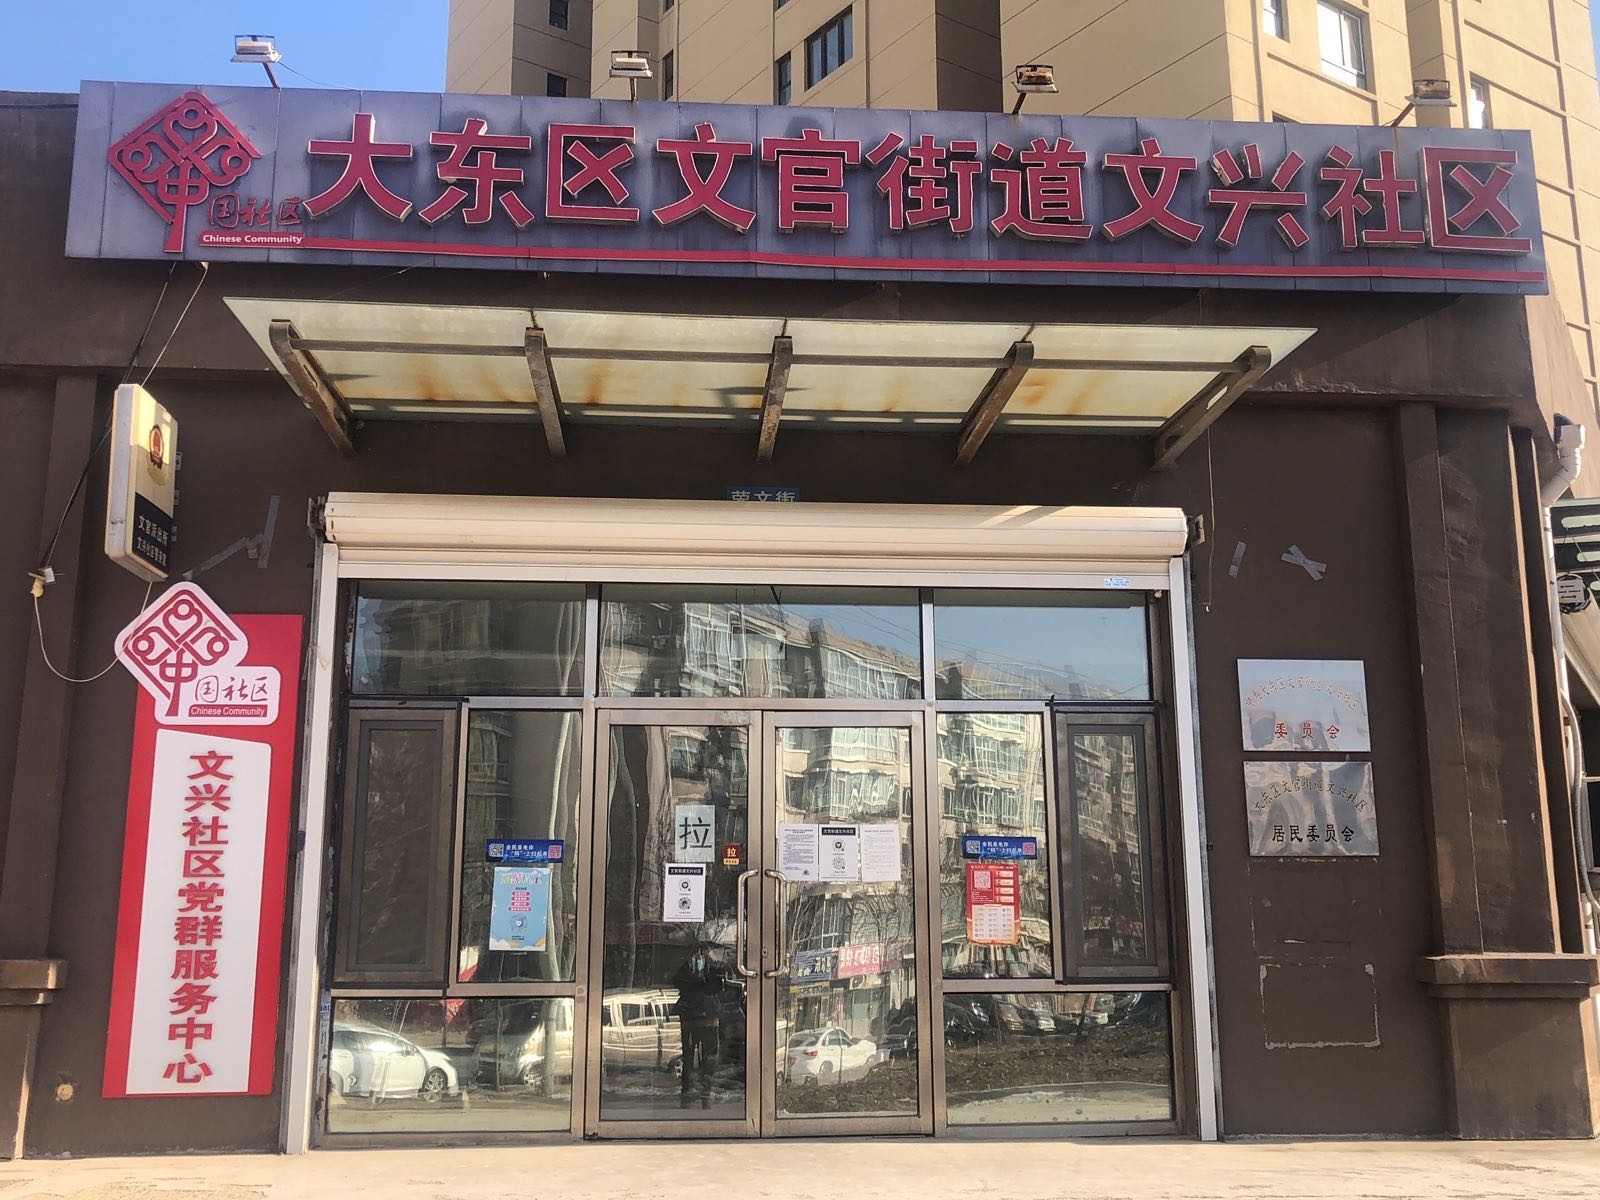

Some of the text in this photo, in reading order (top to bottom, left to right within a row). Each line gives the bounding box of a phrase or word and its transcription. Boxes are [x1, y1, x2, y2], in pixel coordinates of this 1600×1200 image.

[303, 112, 1533, 254] 大东区文官街道文兴社区
[202, 234, 303, 245] Chinese Community
[190, 706, 265, 718] Chinese Community
[1274, 722, 1340, 740] 委员会
[678, 816, 713, 851] 拉
[1271, 824, 1355, 843] 居民委员会
[726, 847, 737, 857] 拉
[162, 750, 234, 1084] 文兴社区党群服务中心
